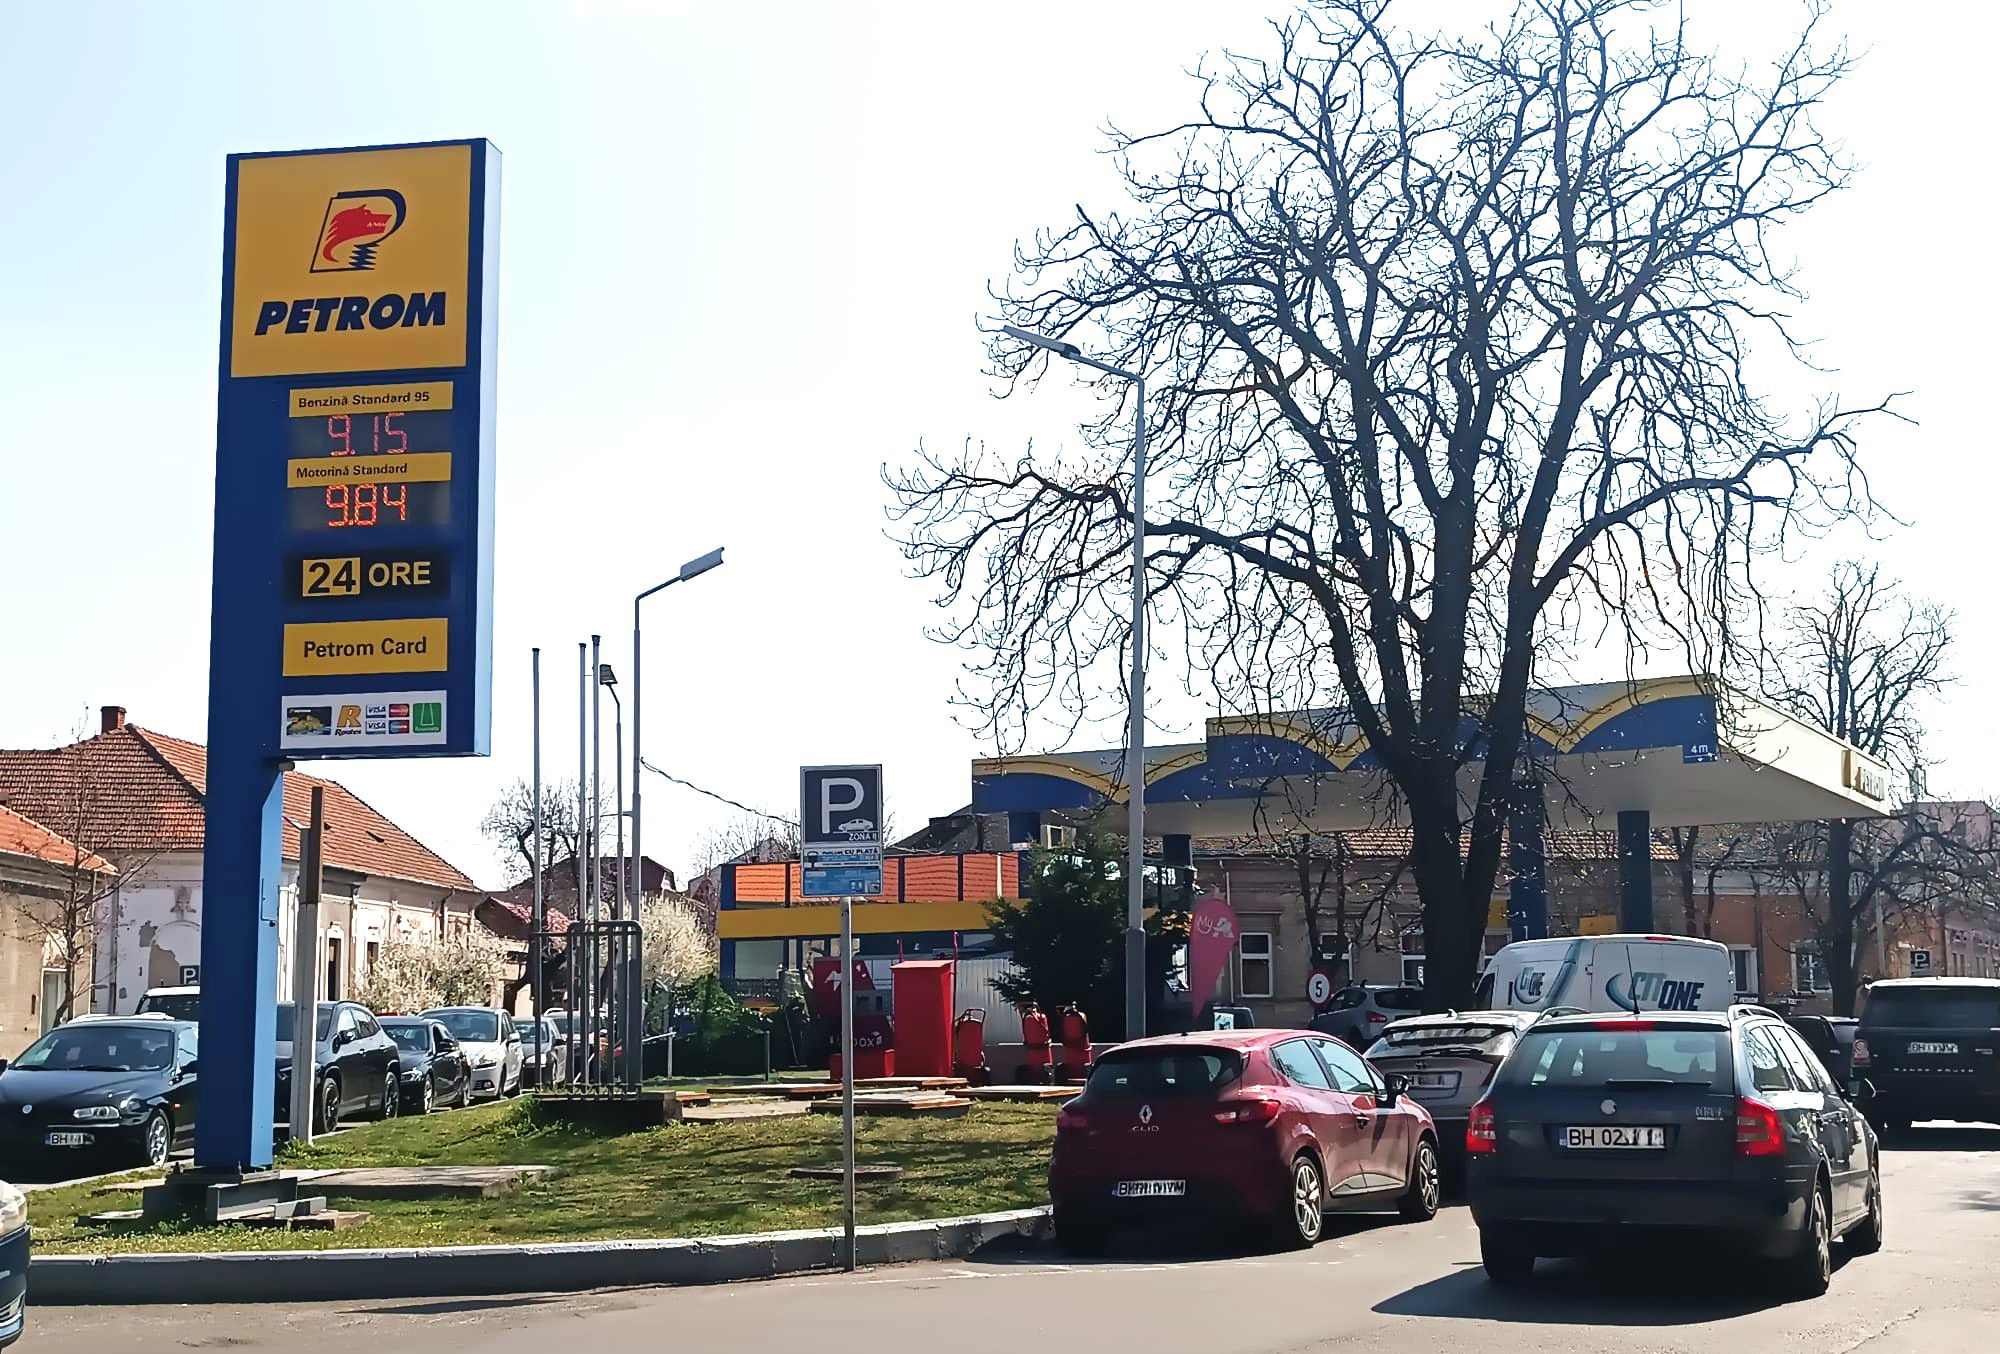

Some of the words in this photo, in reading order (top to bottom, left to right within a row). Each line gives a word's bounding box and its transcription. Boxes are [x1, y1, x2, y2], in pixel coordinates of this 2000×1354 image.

[254, 291, 447, 336] PETROM
[352, 391, 411, 406] Standard
[414, 391, 430, 402] 95
[328, 412, 408, 456] 9.15
[352, 463, 408, 476] Standard
[326, 483, 408, 527] 9.84
[307, 561, 356, 594] 24
[368, 561, 431, 587] ORE
[303, 640, 374, 658] Petrom
[381, 636, 427, 655] Card
[368, 705, 386, 714] VISA
[368, 721, 386, 730] VISA
[821, 777, 864, 834] P
[848, 831, 871, 841] ZONA
[1914, 952, 1927, 967] P
[183, 967, 196, 985] P
[1315, 980, 1323, 998] 5
[1569, 1129, 1595, 1146] BH
